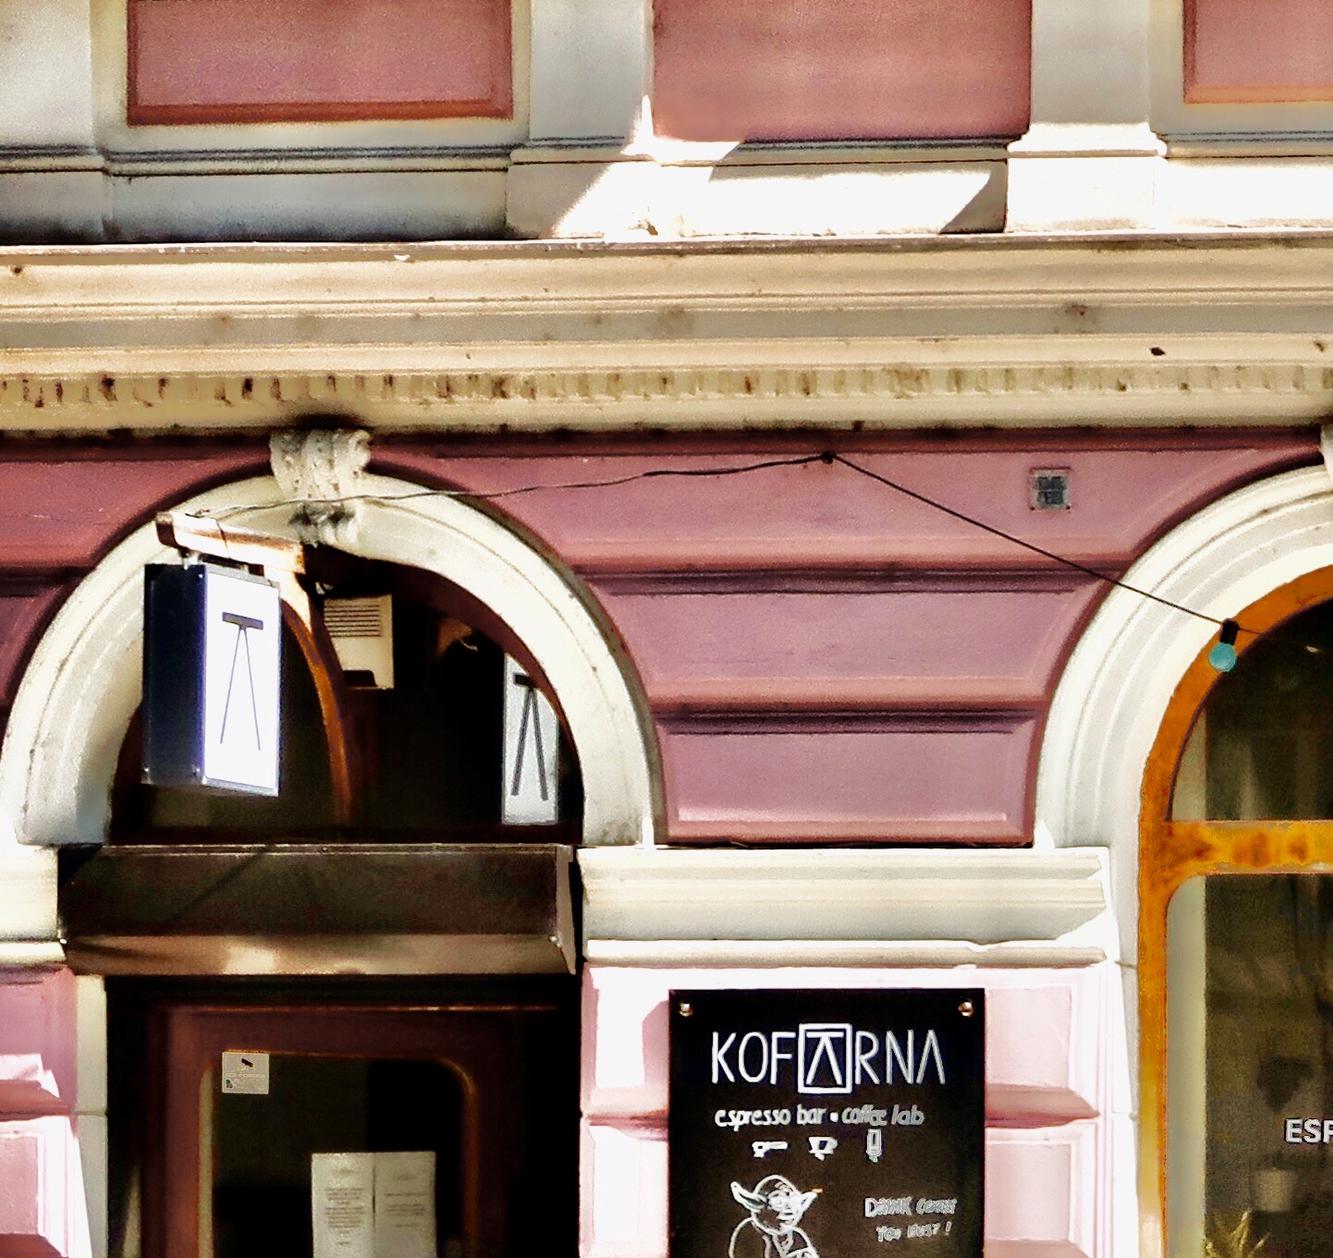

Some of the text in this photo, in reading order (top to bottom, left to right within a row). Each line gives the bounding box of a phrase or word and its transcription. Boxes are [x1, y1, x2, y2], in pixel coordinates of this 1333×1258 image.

[714, 1108, 791, 1132] espresso
[796, 1104, 827, 1125] bar
[891, 1104, 926, 1126] lab
